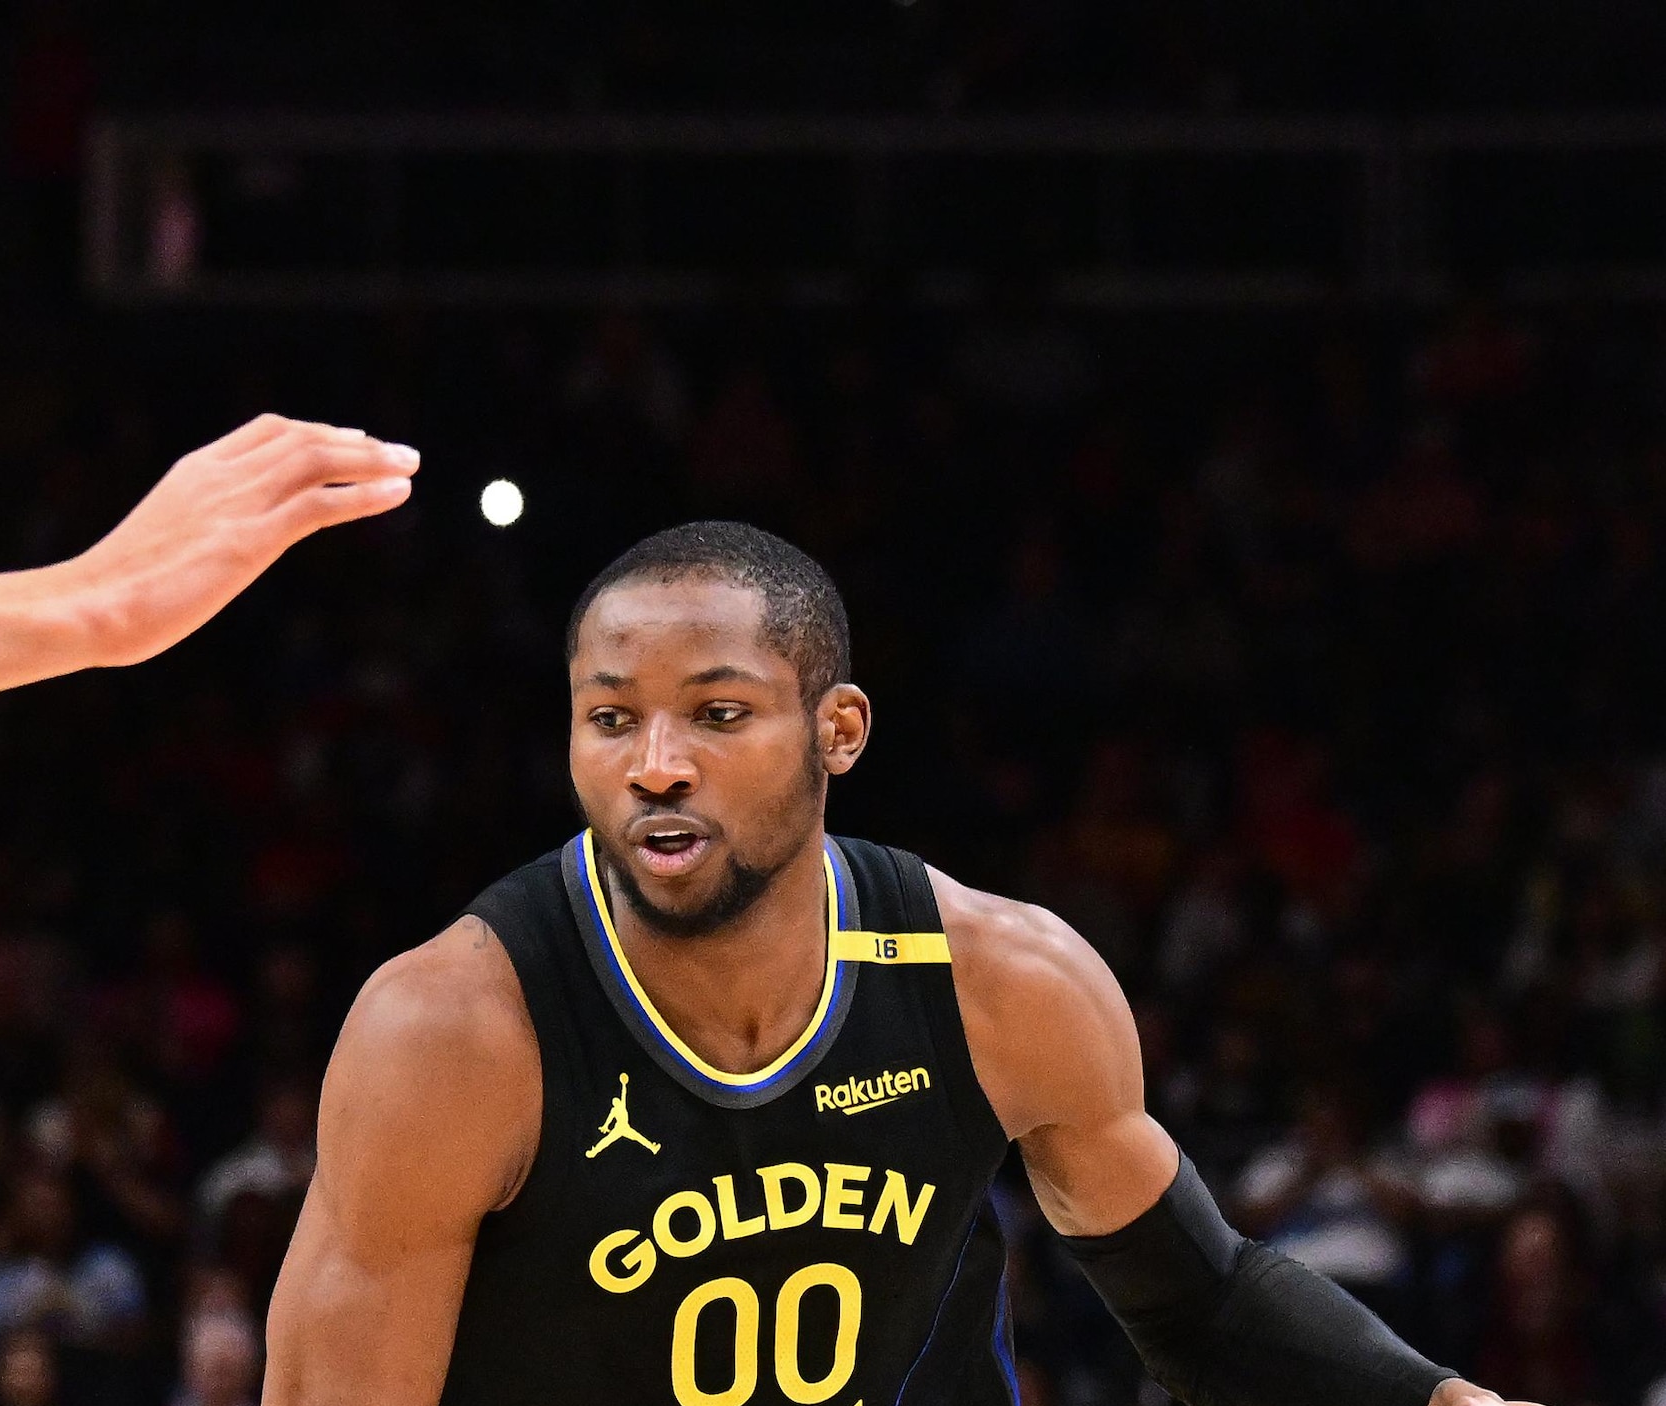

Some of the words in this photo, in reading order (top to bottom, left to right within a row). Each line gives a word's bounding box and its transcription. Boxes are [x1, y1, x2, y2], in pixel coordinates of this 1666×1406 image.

[875, 938, 898, 960] 16
[815, 1065, 931, 1114] Rakuten
[589, 1161, 935, 1294] GOLDEN
